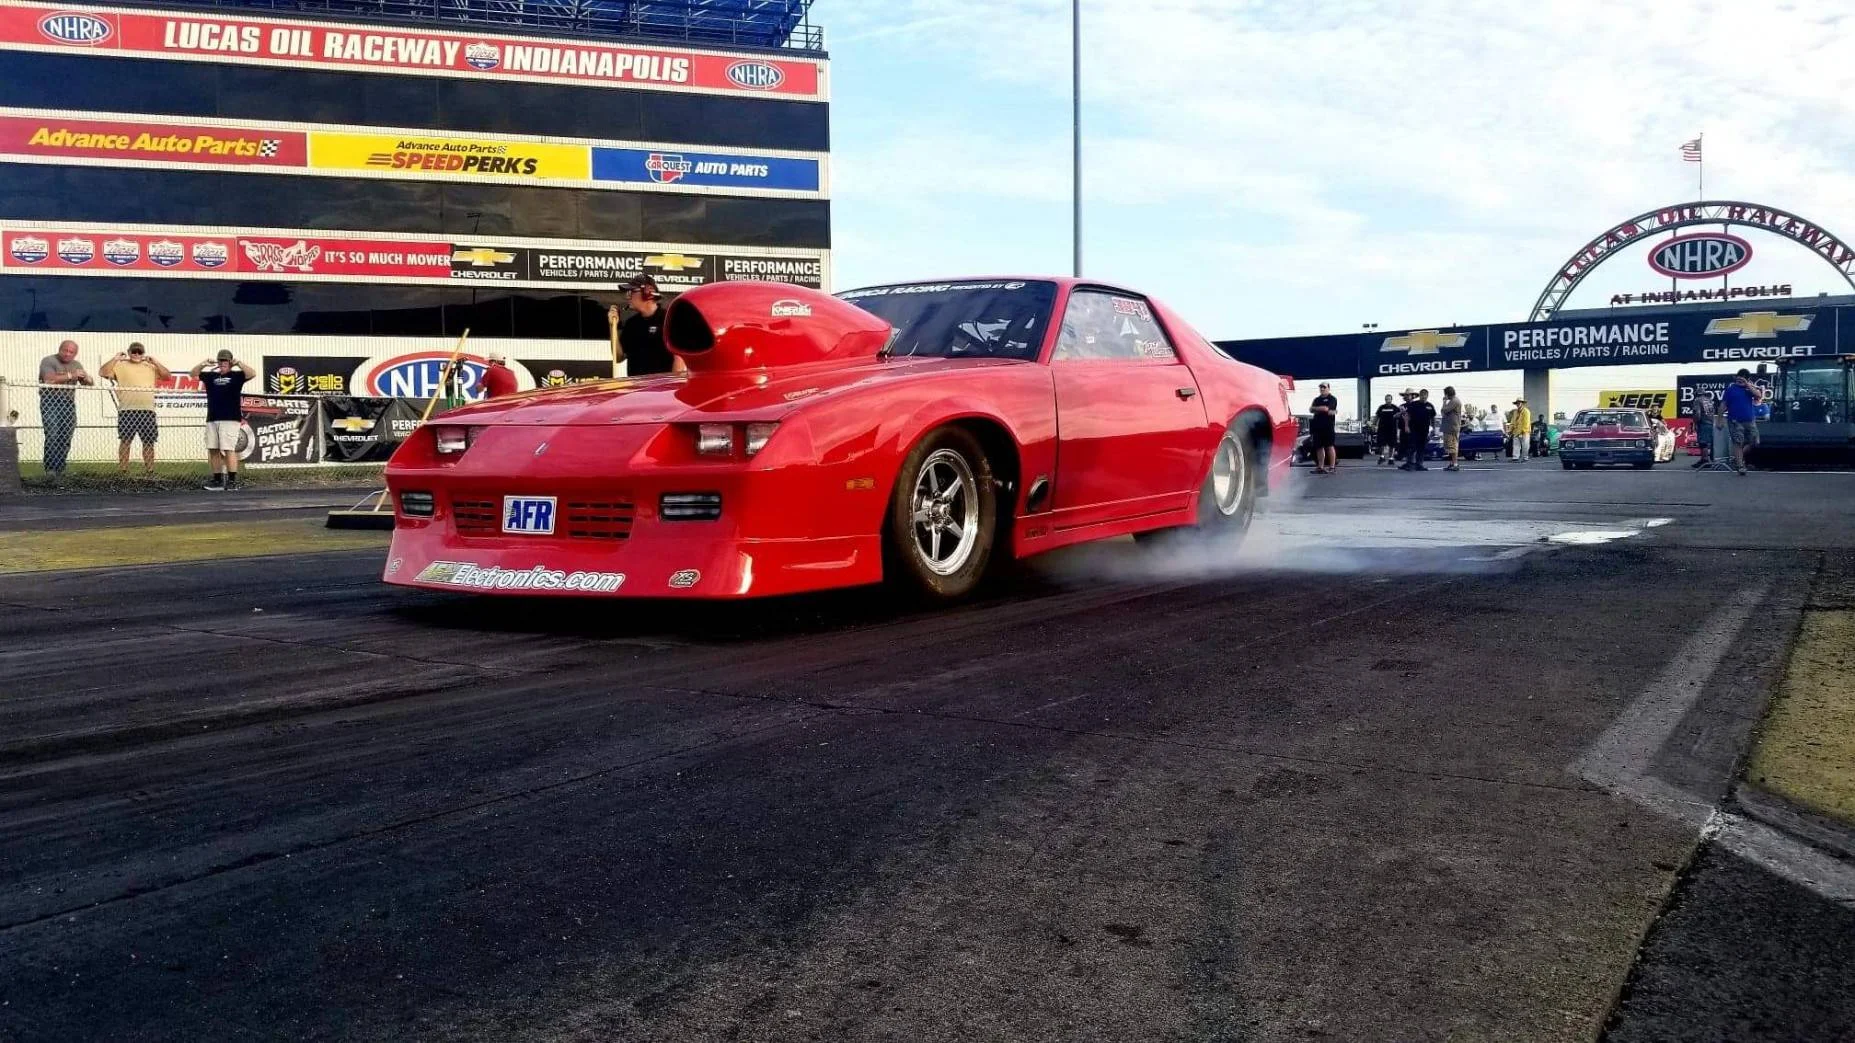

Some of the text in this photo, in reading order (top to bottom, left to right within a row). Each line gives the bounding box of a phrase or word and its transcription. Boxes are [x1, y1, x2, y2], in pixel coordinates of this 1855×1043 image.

[50, 17, 102, 40] NHRA
[164, 21, 461, 66] LUCAS OIL RACEWAY
[504, 45, 689, 83] INDIANAPOLIS
[735, 64, 777, 85] NHRA
[29, 127, 257, 156] Advance Auto Parts
[396, 140, 496, 154] Advance Auto Parts
[390, 152, 538, 175] SPEEDPERKS
[646, 159, 769, 177] CARQUEST AUTO PARTS
[1656, 206, 1703, 225] OIL
[1727, 206, 1855, 265] RACEWAY
[325, 251, 450, 267] IT'S SO MUCH MOWER
[539, 255, 643, 271] PERFORMANCE
[1663, 240, 1739, 273] NHRA
[450, 270, 517, 280] CHEVROLET
[540, 269, 578, 278] VEHICLES
[584, 270, 609, 278] PARTS
[725, 259, 820, 275] PERFORMANCE
[725, 273, 760, 282] VEHICLES
[766, 274, 788, 282] PARTS
[794, 274, 820, 283] RACING
[1611, 284, 1792, 305] AT INDIANAPOLIS
[1504, 322, 1669, 349] PERFORMANCE
[1505, 348, 1561, 361] VEHICLES
[1572, 346, 1610, 358] PARTS
[1622, 343, 1669, 356] RACING
[1703, 345, 1816, 360] CHEVROLET
[1379, 359, 1472, 374] CHEVROLET
[1620, 392, 1668, 408] JEGS
[1792, 401, 1801, 410] 2
[257, 421, 298, 435] FACTORY
[259, 429, 300, 447] PARTS
[262, 440, 301, 461] FAST
[507, 500, 553, 530] AFR
[451, 564, 625, 592] Electronics.com
